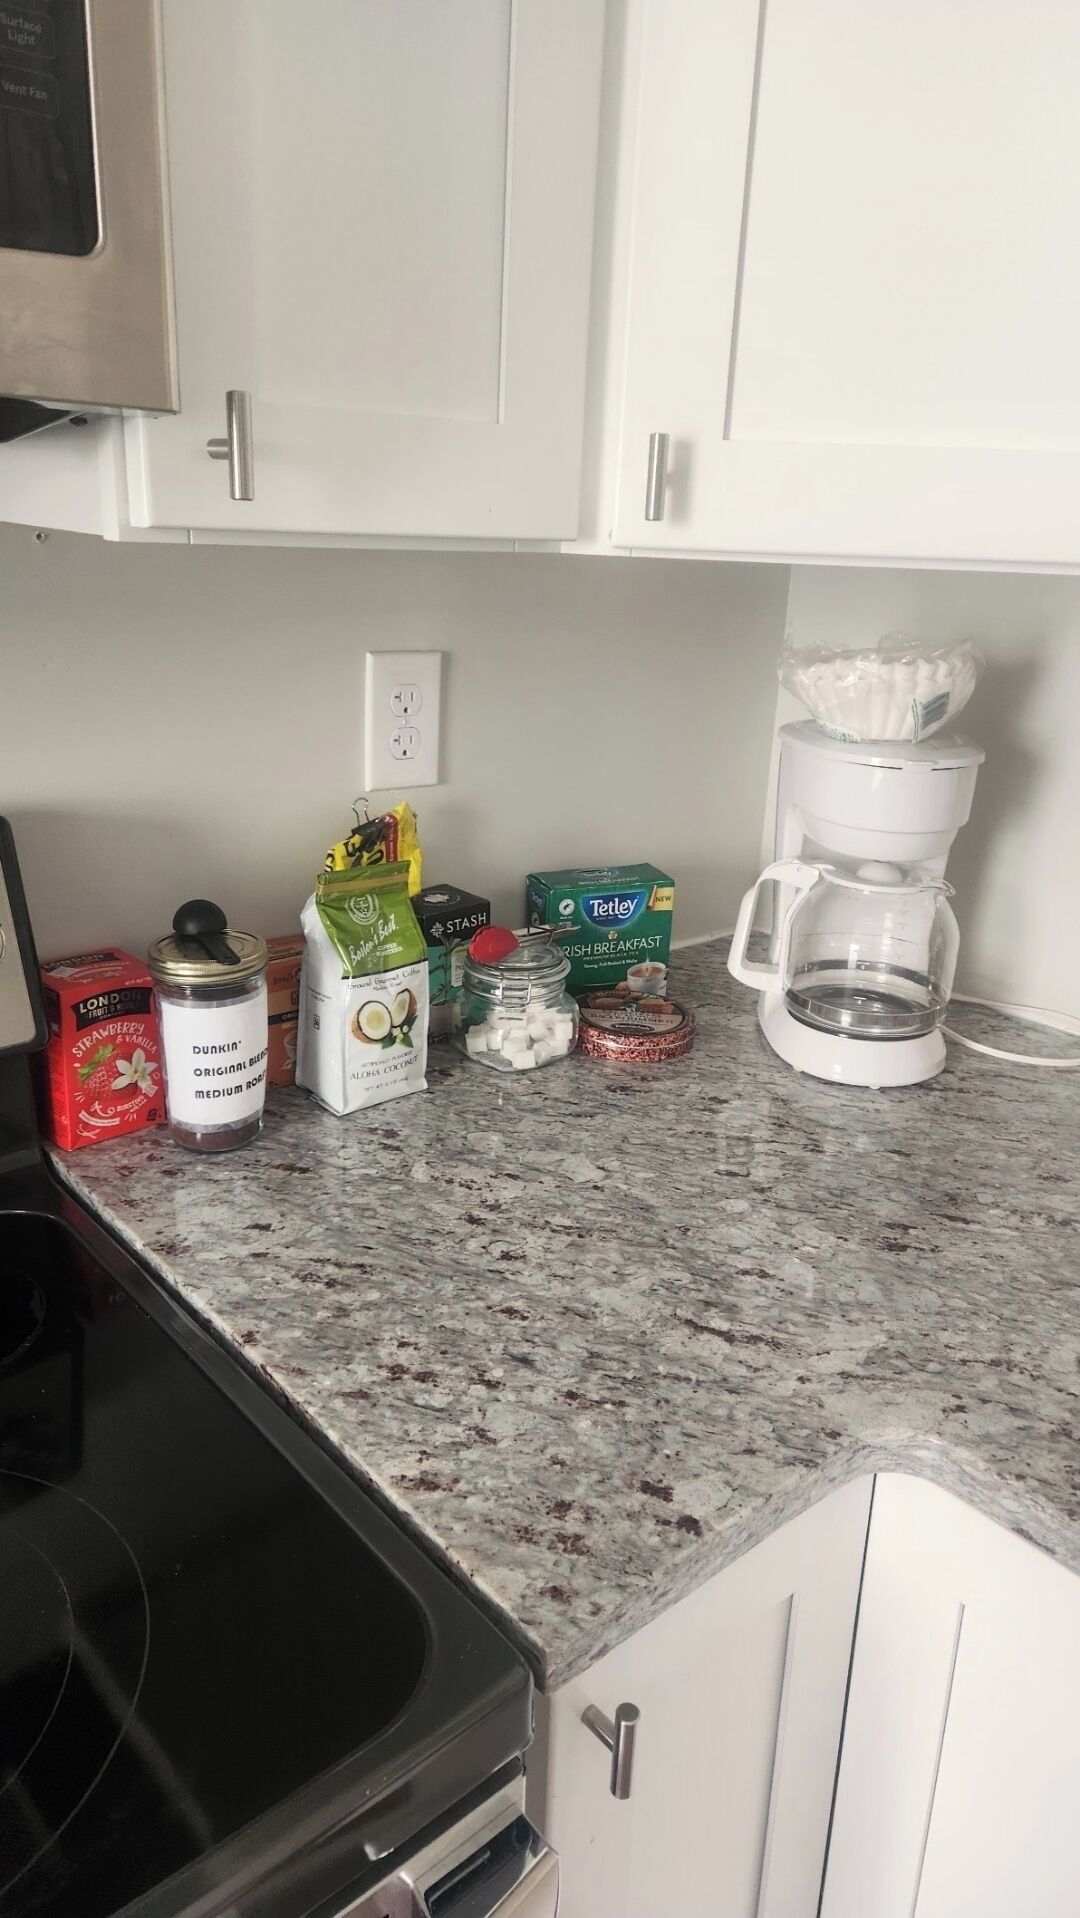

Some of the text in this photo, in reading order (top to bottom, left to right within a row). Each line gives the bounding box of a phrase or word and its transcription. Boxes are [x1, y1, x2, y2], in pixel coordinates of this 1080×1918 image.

[0, 12, 42, 33] Surface
[7, 29, 36, 46] Light
[2, 80, 48, 101] Vent Fan
[590, 897, 639, 919] Tetley
[447, 912, 487, 933] STASH
[593, 935, 663, 955] BREAKFAST
[80, 989, 142, 1014] LONDON
[88, 1007, 108, 1019] FRUIT
[72, 1022, 145, 1058] STRAWBERRY
[125, 1035, 158, 1054] VANILLA
[192, 1040, 242, 1055] DUNKIN'
[193, 1061, 247, 1077] ORIGINAL
[350, 1054, 419, 1080] ALOHA COCONUT
[195, 1084, 243, 1099] MEDIUM
